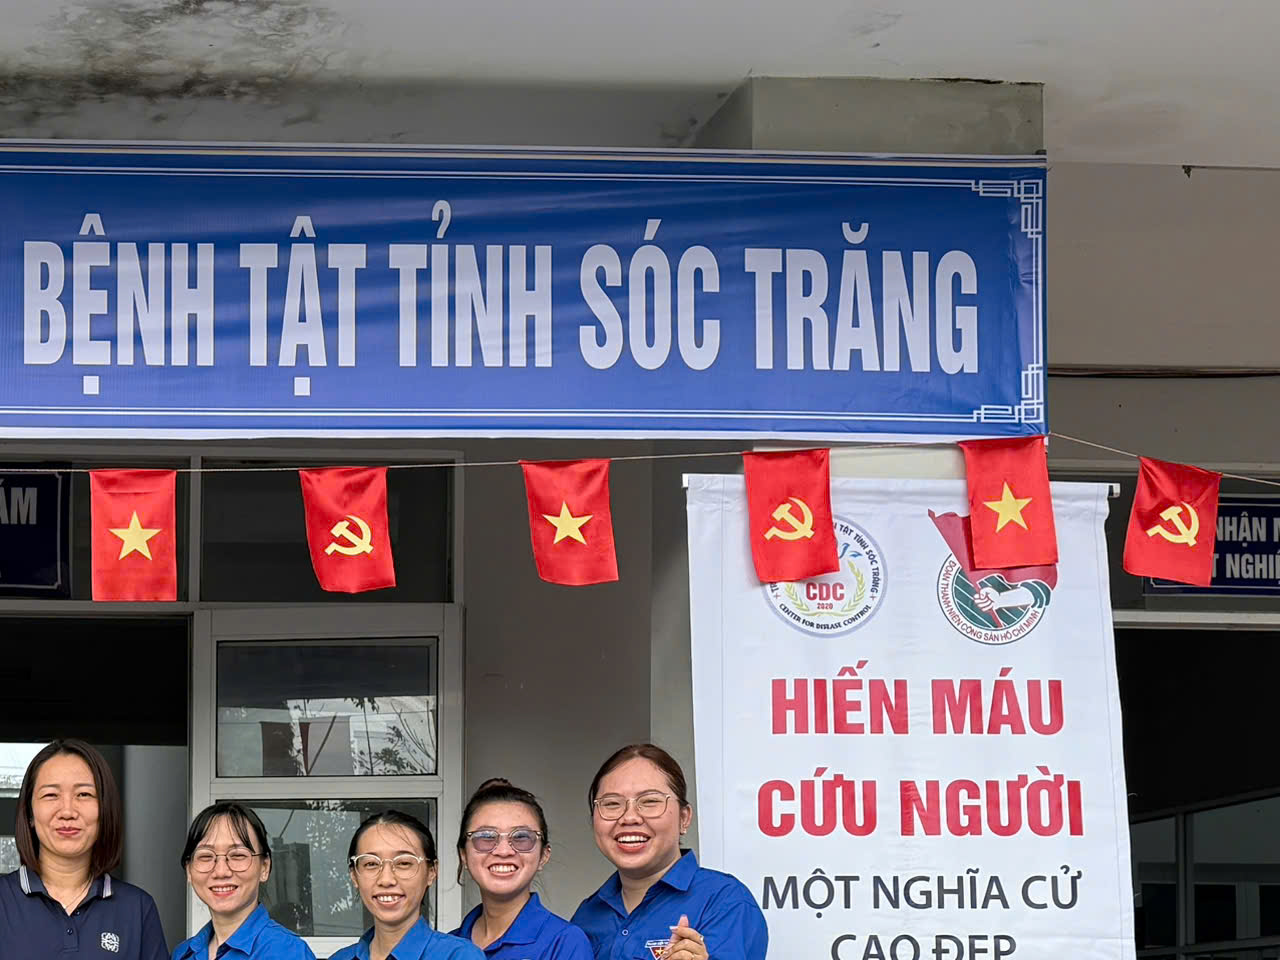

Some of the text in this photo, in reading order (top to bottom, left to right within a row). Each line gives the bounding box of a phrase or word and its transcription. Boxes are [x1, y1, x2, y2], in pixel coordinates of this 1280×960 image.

[23, 213, 216, 395] BỆNH
[239, 216, 367, 396] TẬT
[389, 199, 553, 368] TỈNH
[579, 219, 721, 371] SÓC
[743, 222, 979, 374] TRĂNG
[779, 603, 802, 623] CENTER
[801, 618, 815, 629] FOR
[843, 604, 872, 626] CONTROL
[806, 582, 845, 601] CDC
[771, 660, 1064, 735] HIẾN MÁU
[757, 766, 1084, 837] CỨU NGƯỜI
[762, 865, 1083, 918] MỘT NGHĨA CỬ
